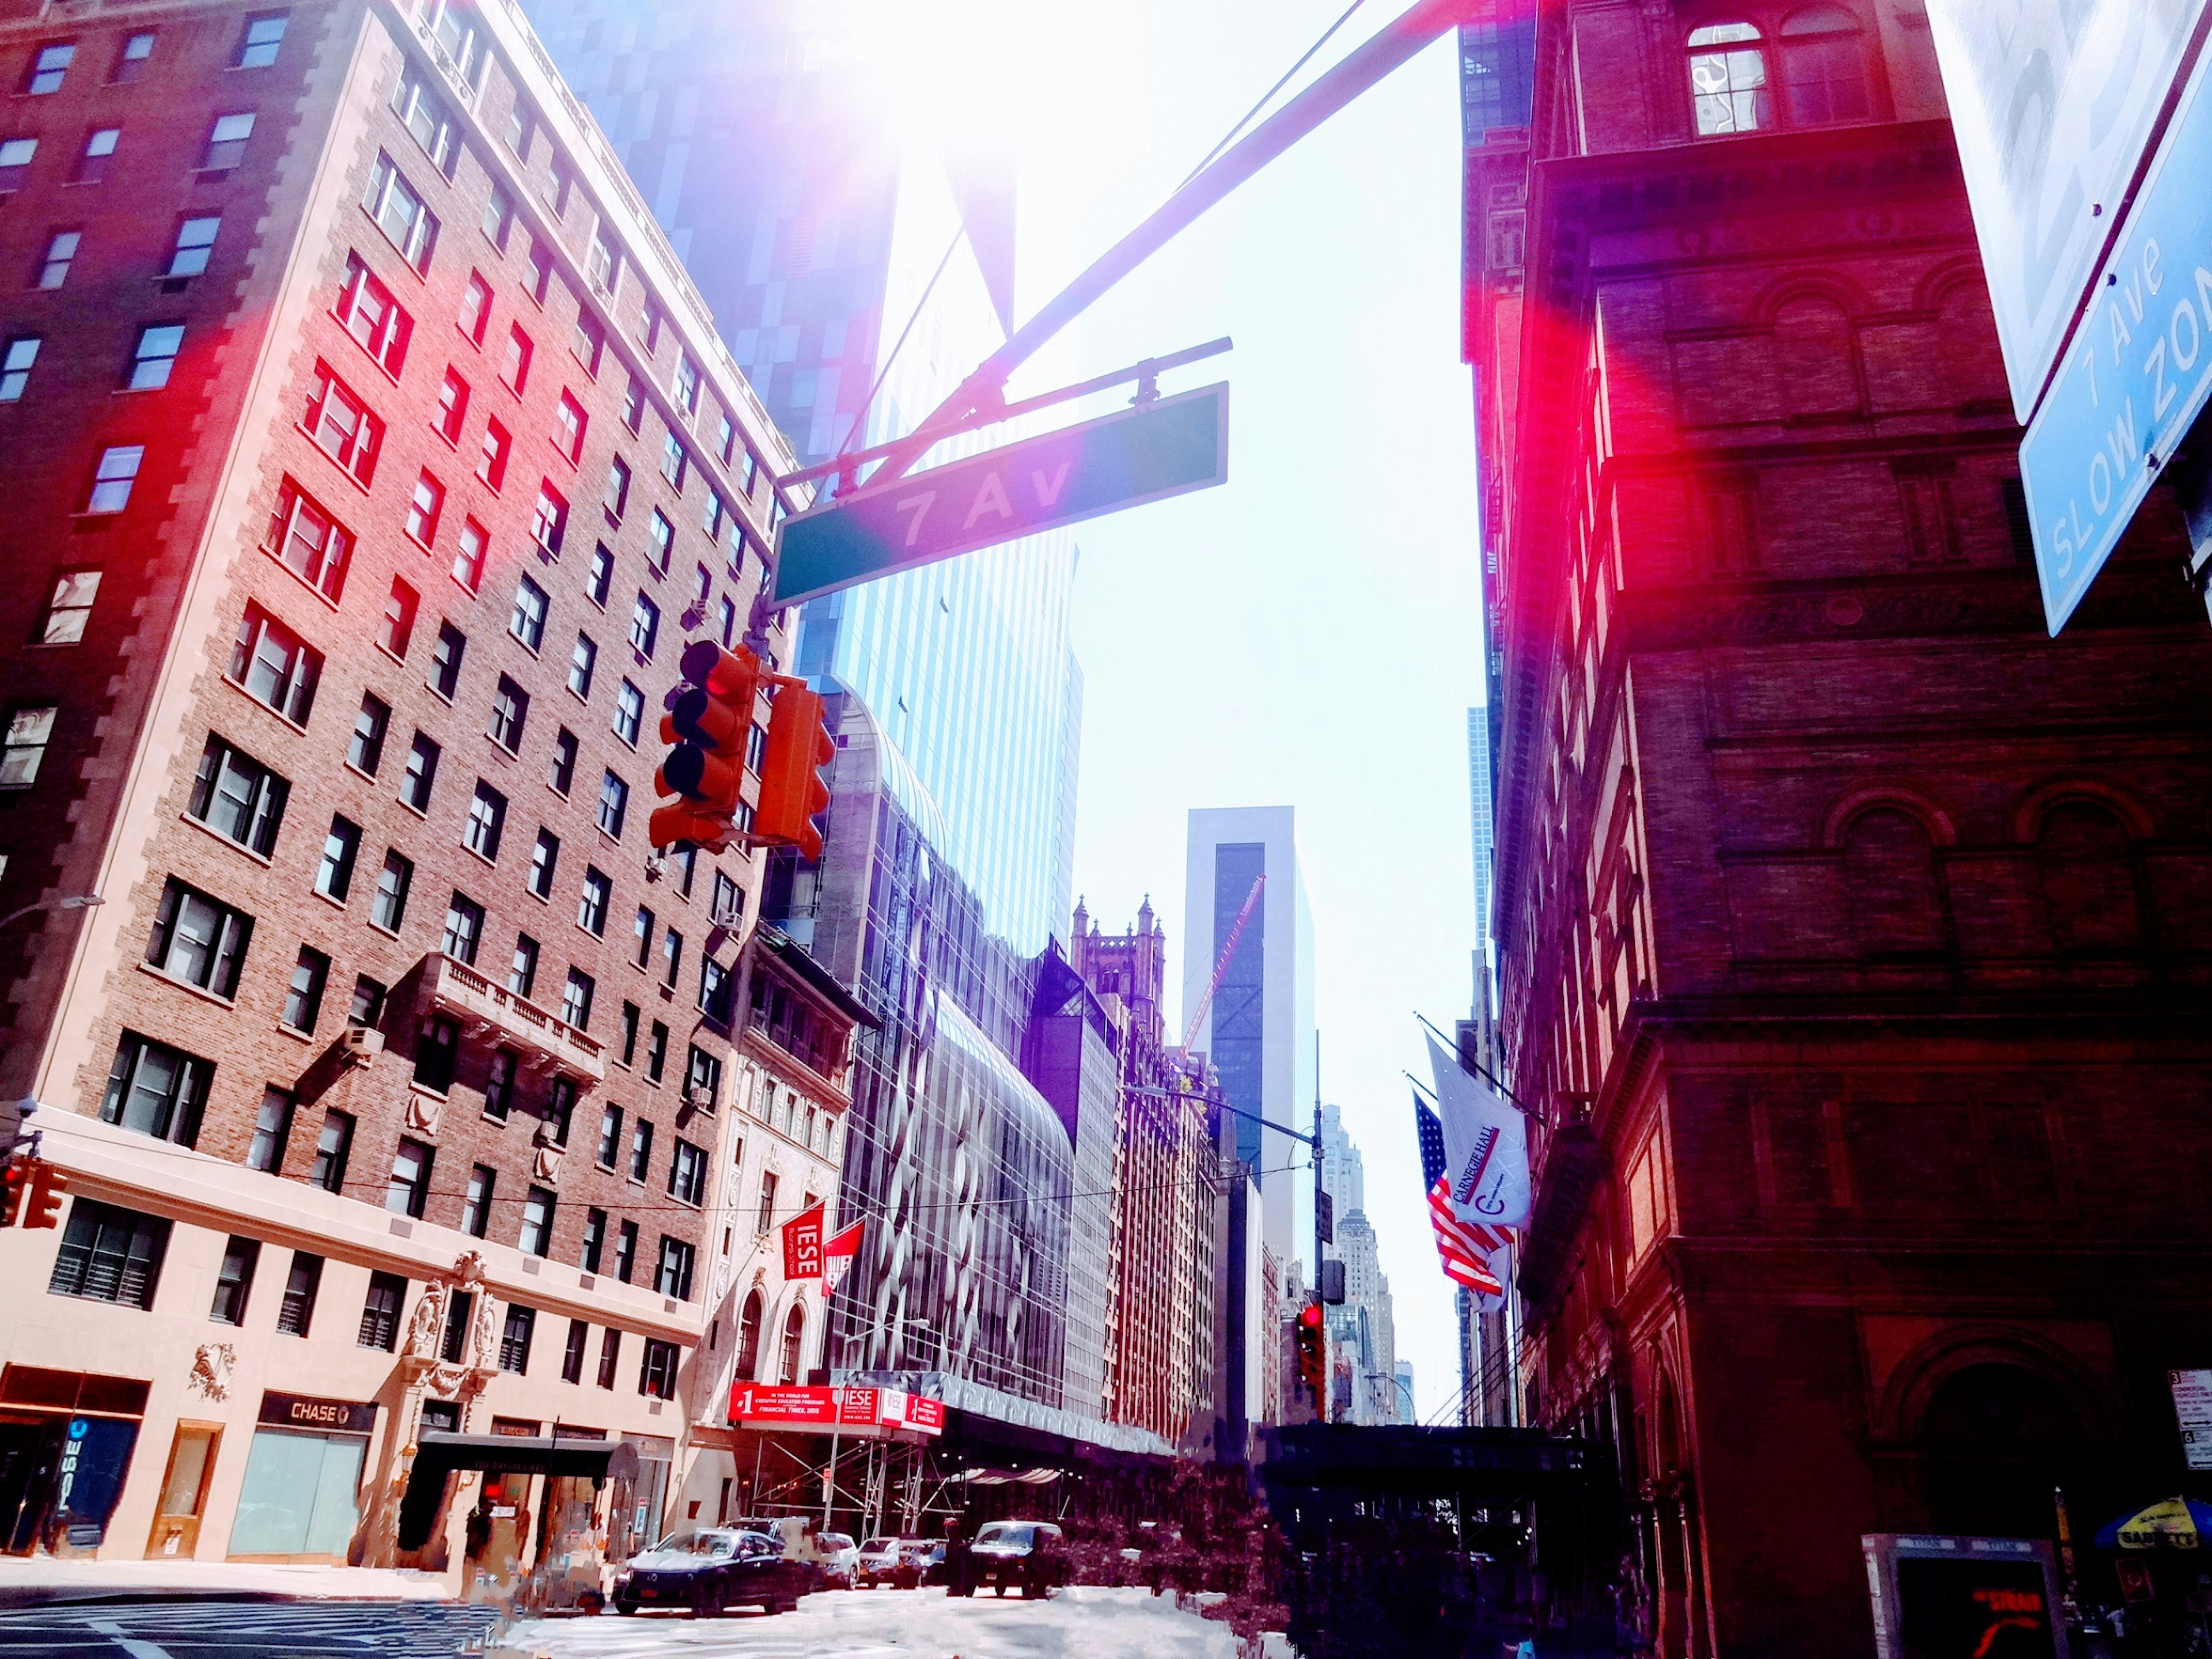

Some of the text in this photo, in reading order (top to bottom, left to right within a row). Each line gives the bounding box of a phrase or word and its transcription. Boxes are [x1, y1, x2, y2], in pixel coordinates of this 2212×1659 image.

[2082, 237, 2165, 408] 7 Ave
[2054, 395, 2137, 579] SLOW
[896, 490, 936, 547] 7
[1453, 1125, 1494, 1203] CARNEGIE HALL
[797, 1225, 817, 1274] IESE
[2171, 1372, 2179, 1384] 3
[291, 1402, 338, 1423] CHASE
[737, 1389, 753, 1414] #1
[844, 1390, 872, 1405] IESE
[2184, 1432, 2192, 1443] 6
